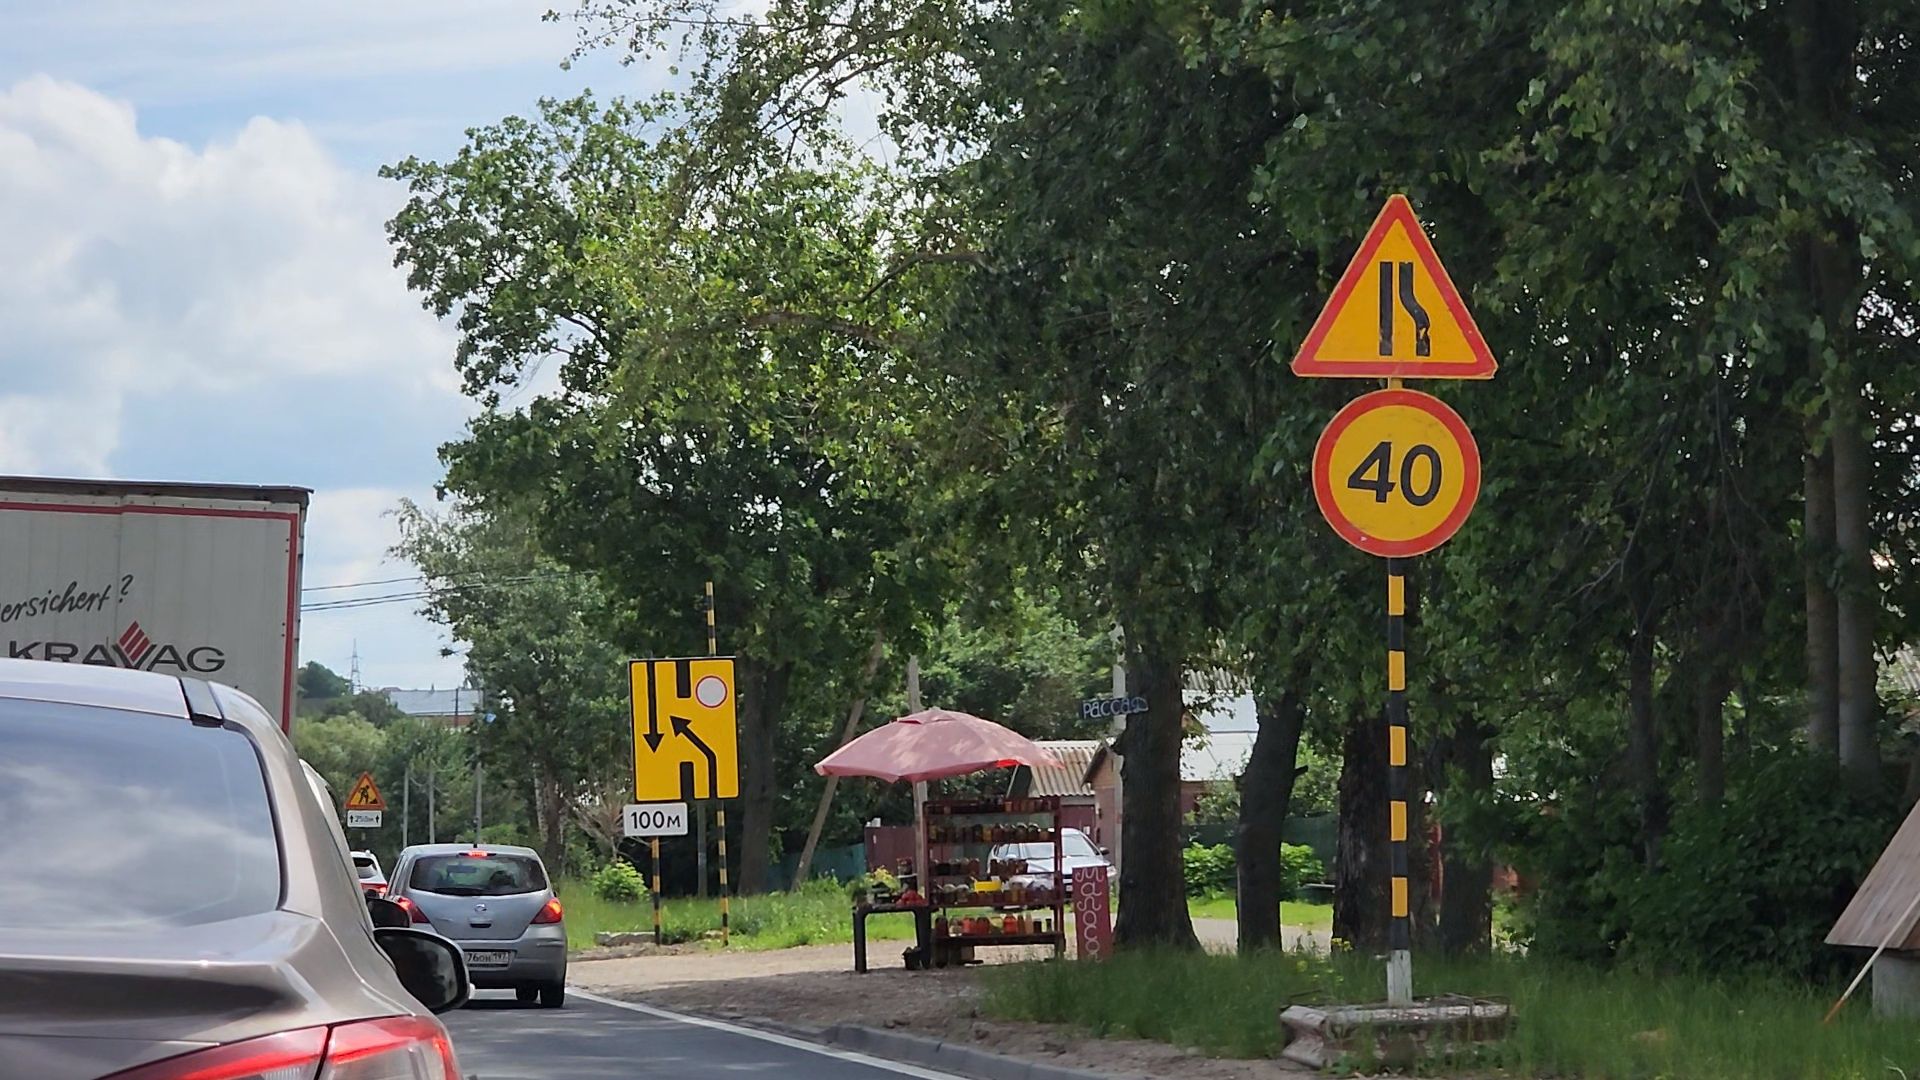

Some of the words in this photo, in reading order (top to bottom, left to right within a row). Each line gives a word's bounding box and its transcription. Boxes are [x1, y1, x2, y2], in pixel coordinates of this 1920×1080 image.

[1347, 441, 1442, 507] 40
[0, 574, 134, 622] ersichert?
[9, 640, 226, 673] KRAVAG
